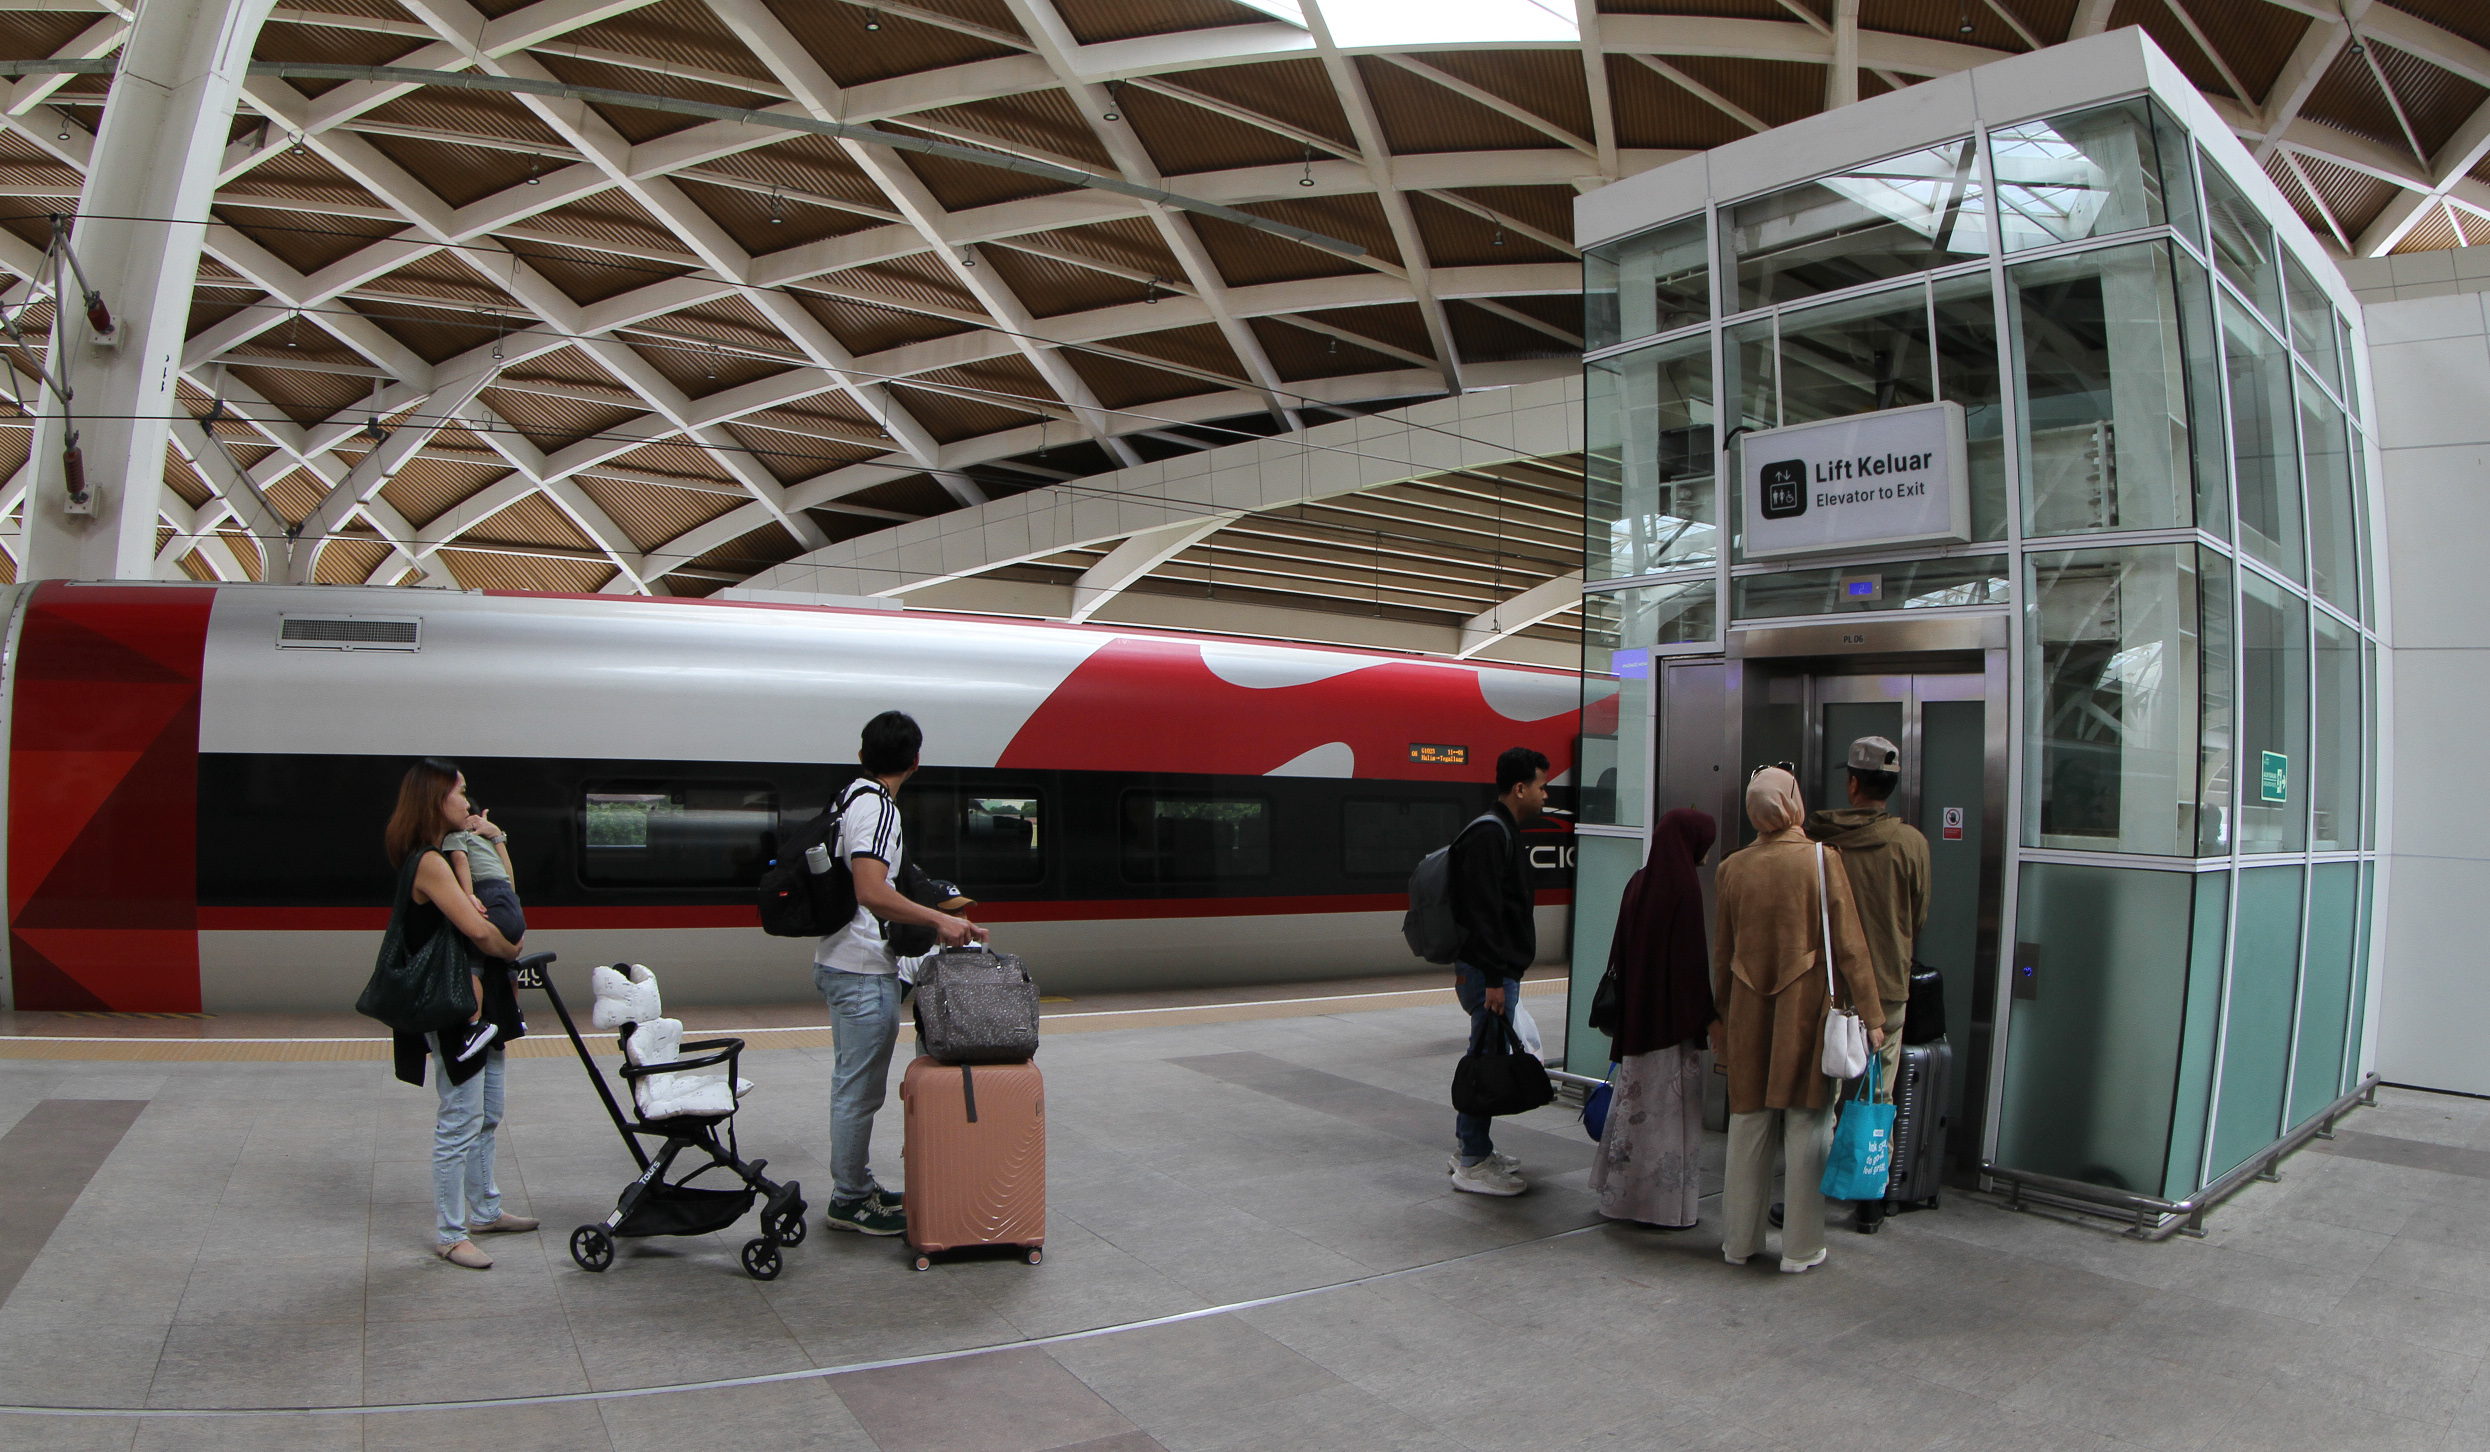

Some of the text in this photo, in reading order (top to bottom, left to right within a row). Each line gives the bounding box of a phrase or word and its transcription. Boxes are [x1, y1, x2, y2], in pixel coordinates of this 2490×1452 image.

[1816, 452, 1932, 483] Lift Keluar
[1816, 481, 1925, 507] Elevator to Exit
[1843, 635, 1853, 644] PL
[638, 1160, 661, 1185] Tours
